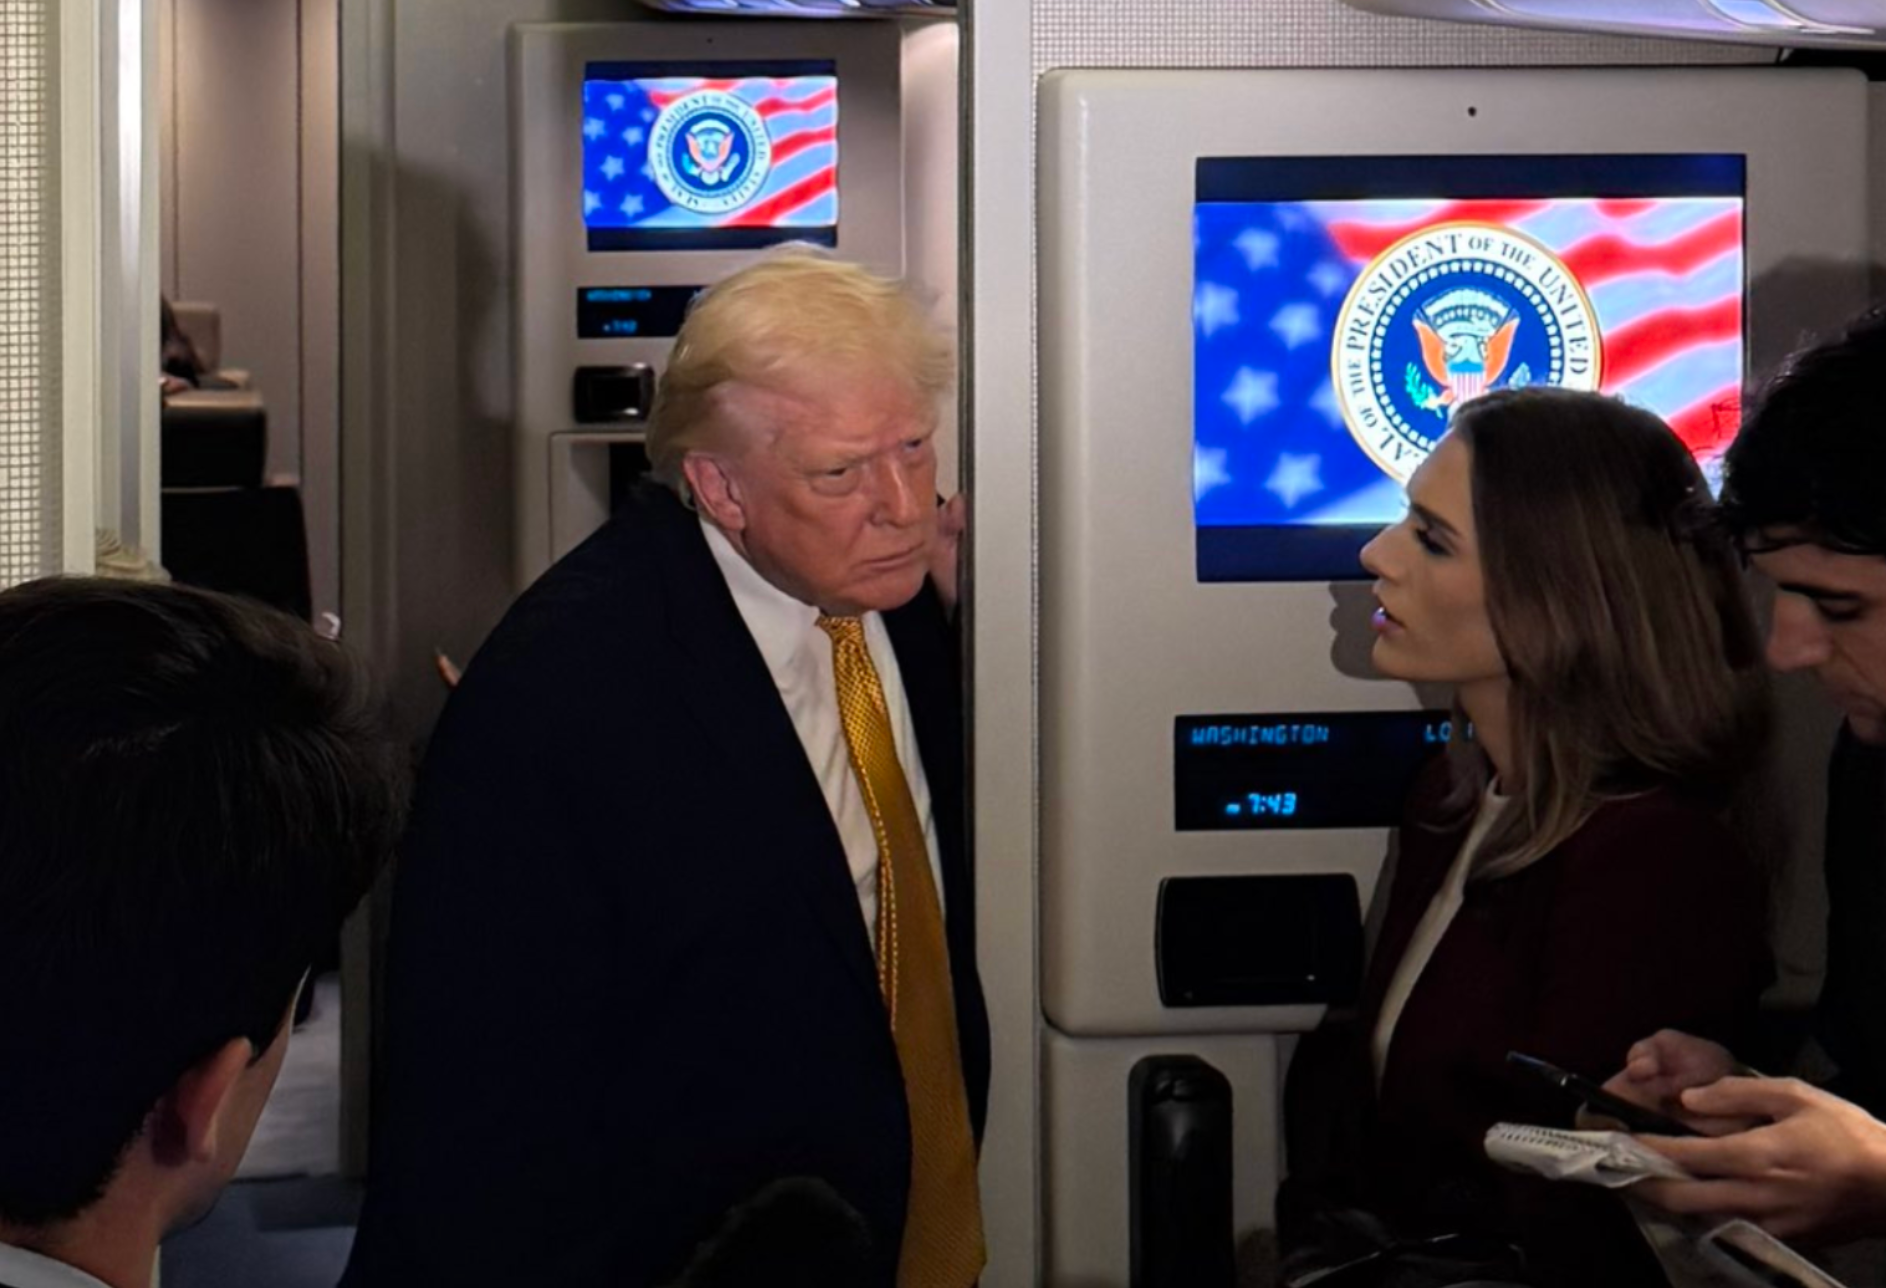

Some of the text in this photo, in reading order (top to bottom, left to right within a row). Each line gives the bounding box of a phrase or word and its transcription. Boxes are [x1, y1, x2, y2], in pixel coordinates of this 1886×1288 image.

[1468, 236, 1496, 252] OF
[1501, 242, 1536, 271] THE
[1346, 233, 1462, 352] PRESIDENT
[1538, 266, 1589, 376] UNITED
[1347, 359, 1366, 397] THE
[1358, 404, 1378, 428] OF
[1191, 724, 1329, 745] WASHINGTON
[1248, 793, 1297, 815] 7:43
